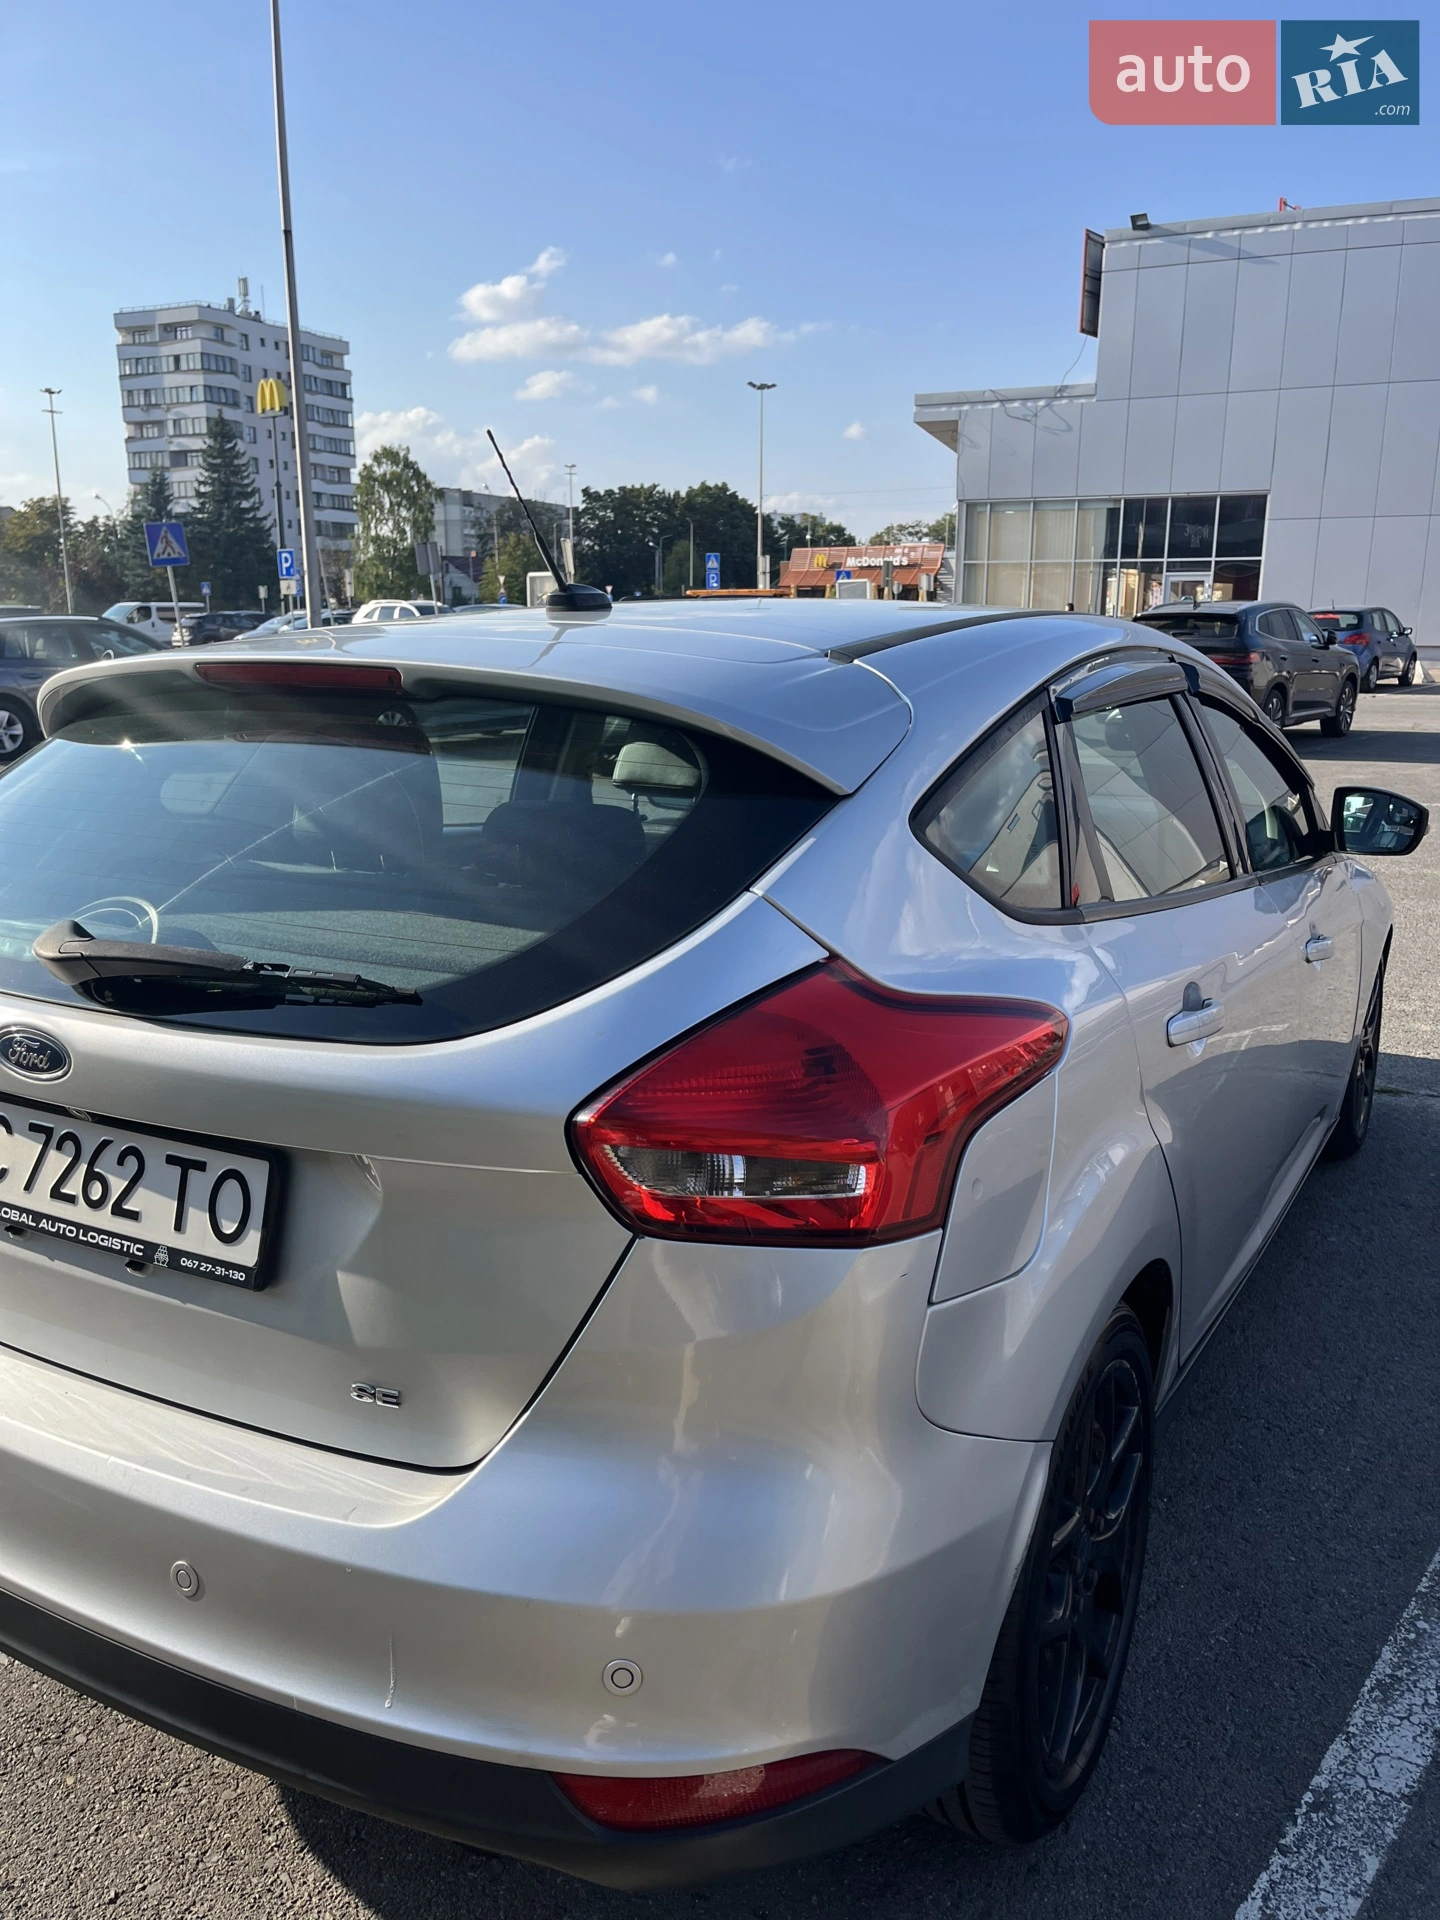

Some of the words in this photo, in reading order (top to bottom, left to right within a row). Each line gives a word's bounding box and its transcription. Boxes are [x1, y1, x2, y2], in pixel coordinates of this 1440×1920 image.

[281, 552, 292, 576] P
[8, 1036, 52, 1070] Ford
[23, 1121, 145, 1221] 7262
[165, 1153, 251, 1244] TO
[0, 1207, 37, 1227] OBAL
[38, 1218, 77, 1238] AUTO
[79, 1229, 145, 1256] LOGISTIC
[180, 1257, 199, 1270] 067
[200, 1262, 246, 1281] 27-31-130
[351, 1383, 400, 1409] SE
